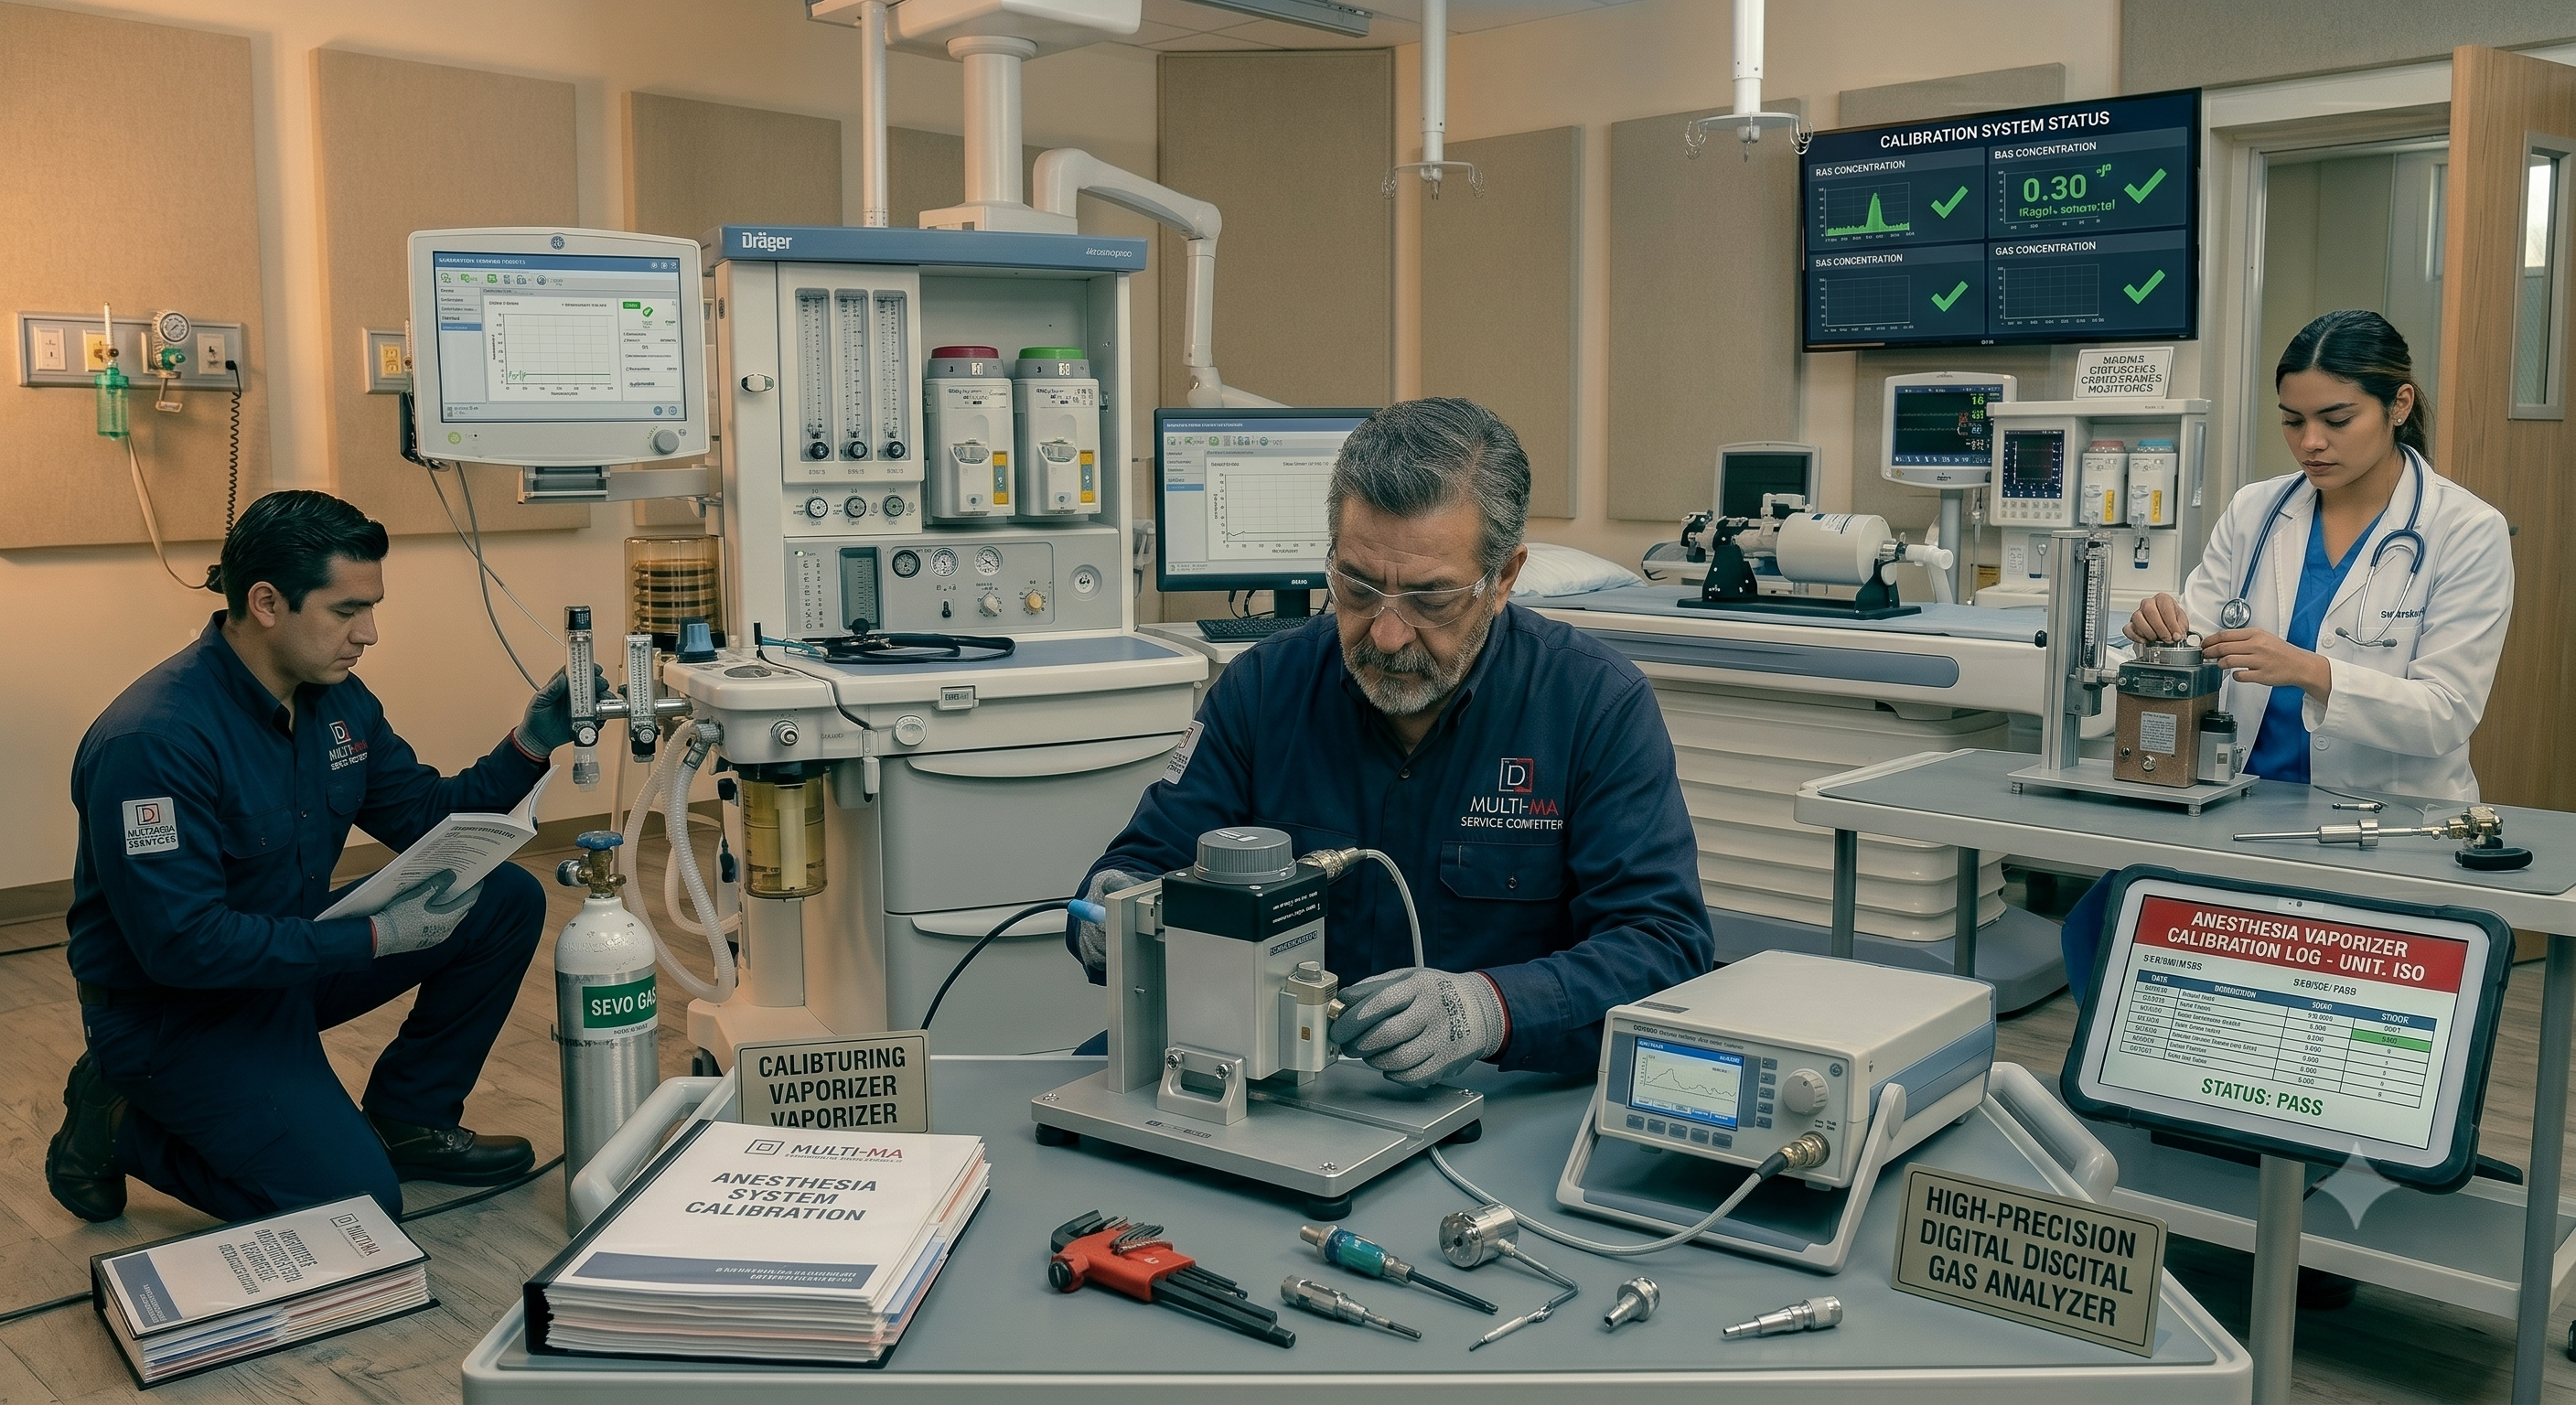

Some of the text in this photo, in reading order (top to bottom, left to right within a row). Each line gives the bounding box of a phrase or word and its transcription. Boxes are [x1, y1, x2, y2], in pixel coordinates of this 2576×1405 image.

[1880, 111, 2110, 148] CALIBRATION SYSTEM STATUS
[1994, 142, 2097, 159] BAS CONCENTRATION
[1816, 160, 1905, 177] RAS CONCENTRATION
[2023, 174, 2087, 202] 0.30
[742, 231, 793, 252] Dräger
[1995, 241, 2096, 255] GAS CONCENTRATION
[1833, 254, 1903, 266] CONCENTRATION
[1508, 765, 1526, 786] D
[1469, 796, 1559, 816] MULTI-MA
[1461, 816, 1504, 829] SERVICE
[2191, 911, 2409, 958] ANESTHESIA VAPORIZER
[2167, 927, 2281, 959] CALIBRATION
[2285, 946, 2323, 966] LOG
[2340, 953, 2387, 976] UNIT.
[2393, 962, 2425, 982] ISO
[591, 986, 657, 1016] SEVO GAS
[758, 1046, 906, 1078] CALIBTURING
[769, 1075, 897, 1105] VAPORIZER
[2201, 1078, 2324, 1116] STATUS: PASS
[770, 1102, 897, 1129] VAPORIZER
[790, 1144, 903, 1159] MULTI-MA
[711, 1172, 877, 1192] ANESTHESIA
[728, 1188, 839, 1205] SYSTEM
[685, 1201, 867, 1221] CALIBRATION
[1926, 1186, 2136, 1259] HIGH-PRECISION
[1921, 1218, 2133, 1294] DIGITAL DISCITAL
[1928, 1255, 2116, 1326] GAS ANALYZER
